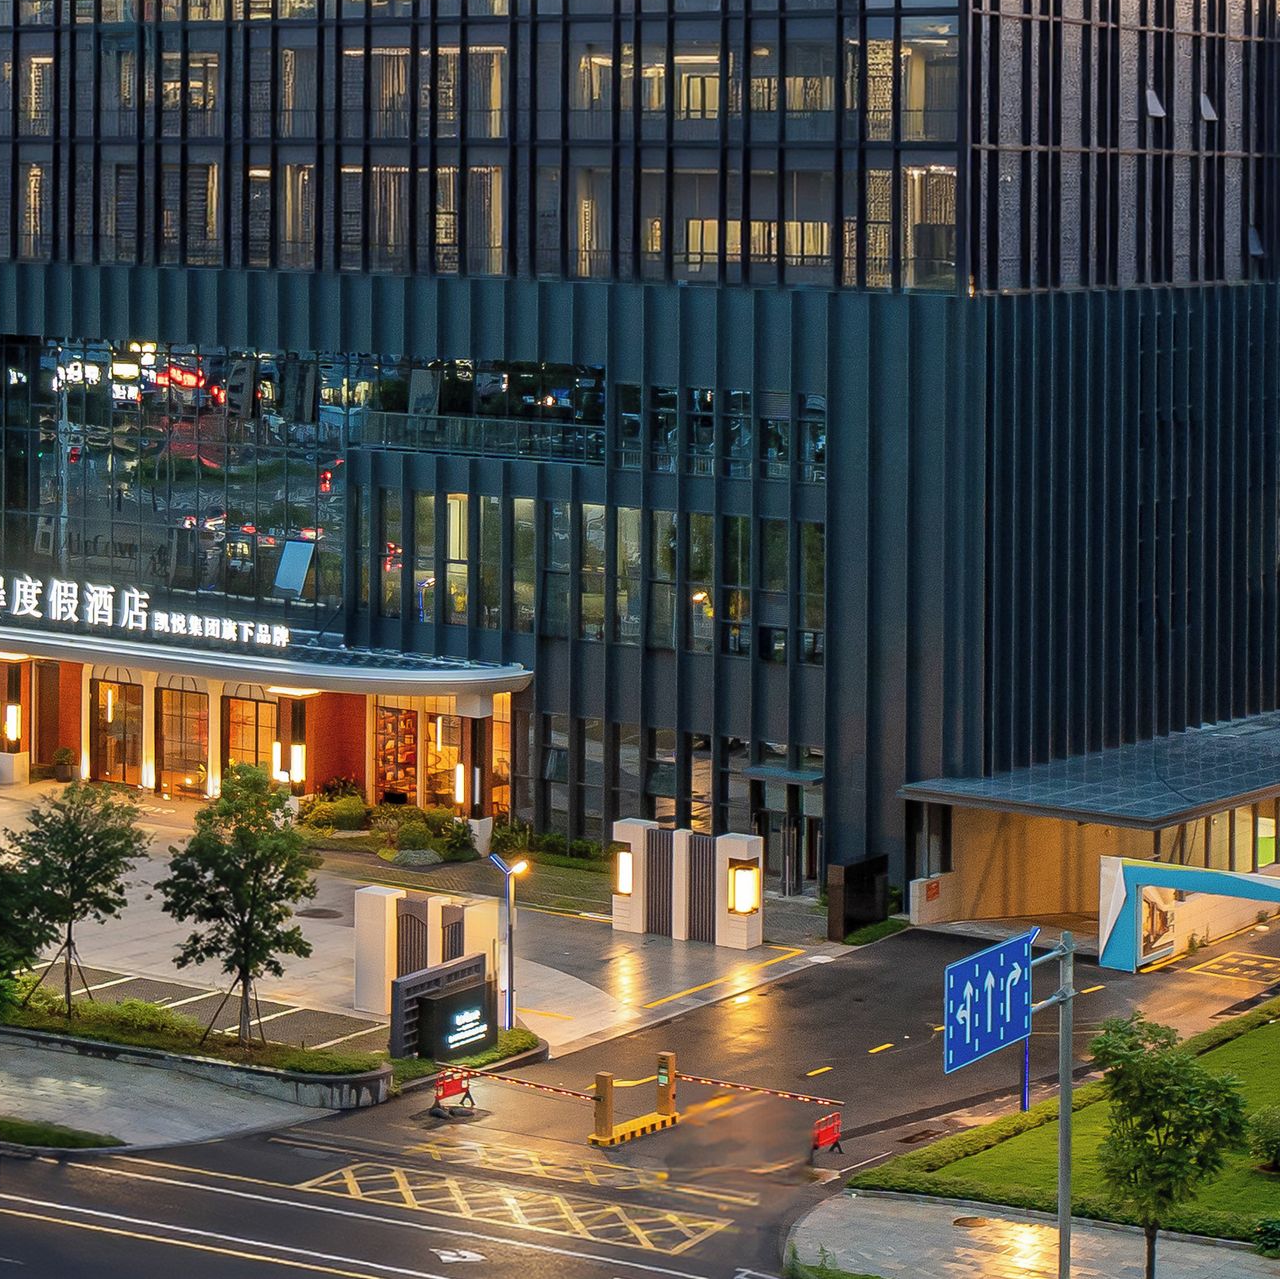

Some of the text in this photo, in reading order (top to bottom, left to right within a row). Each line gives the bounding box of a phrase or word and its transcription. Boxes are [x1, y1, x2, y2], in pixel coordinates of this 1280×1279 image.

[152, 610, 290, 648] 凯悦集团旗下品牌
